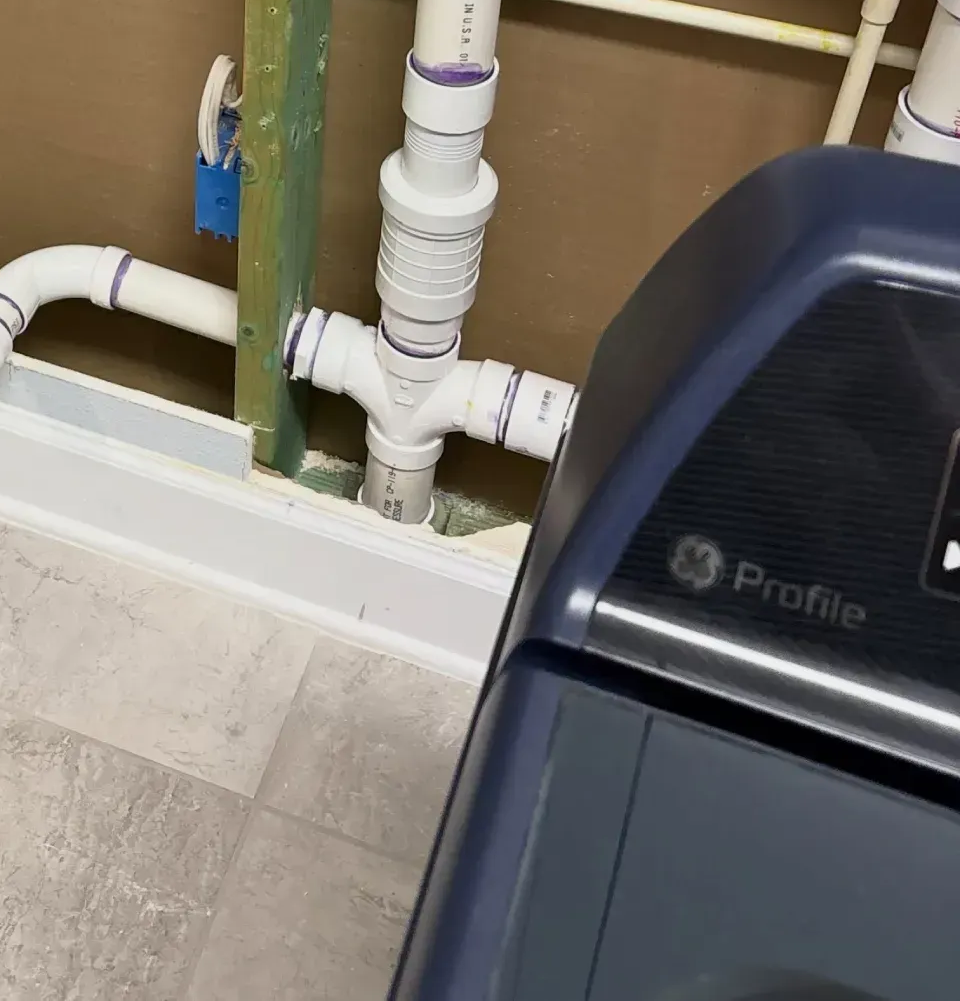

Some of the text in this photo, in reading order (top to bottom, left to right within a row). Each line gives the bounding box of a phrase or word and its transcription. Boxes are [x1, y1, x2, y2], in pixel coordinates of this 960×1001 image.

[464, 3, 474, 14] IN
[392, 498, 404, 522] ESSURE
[732, 560, 867, 630] Profile
